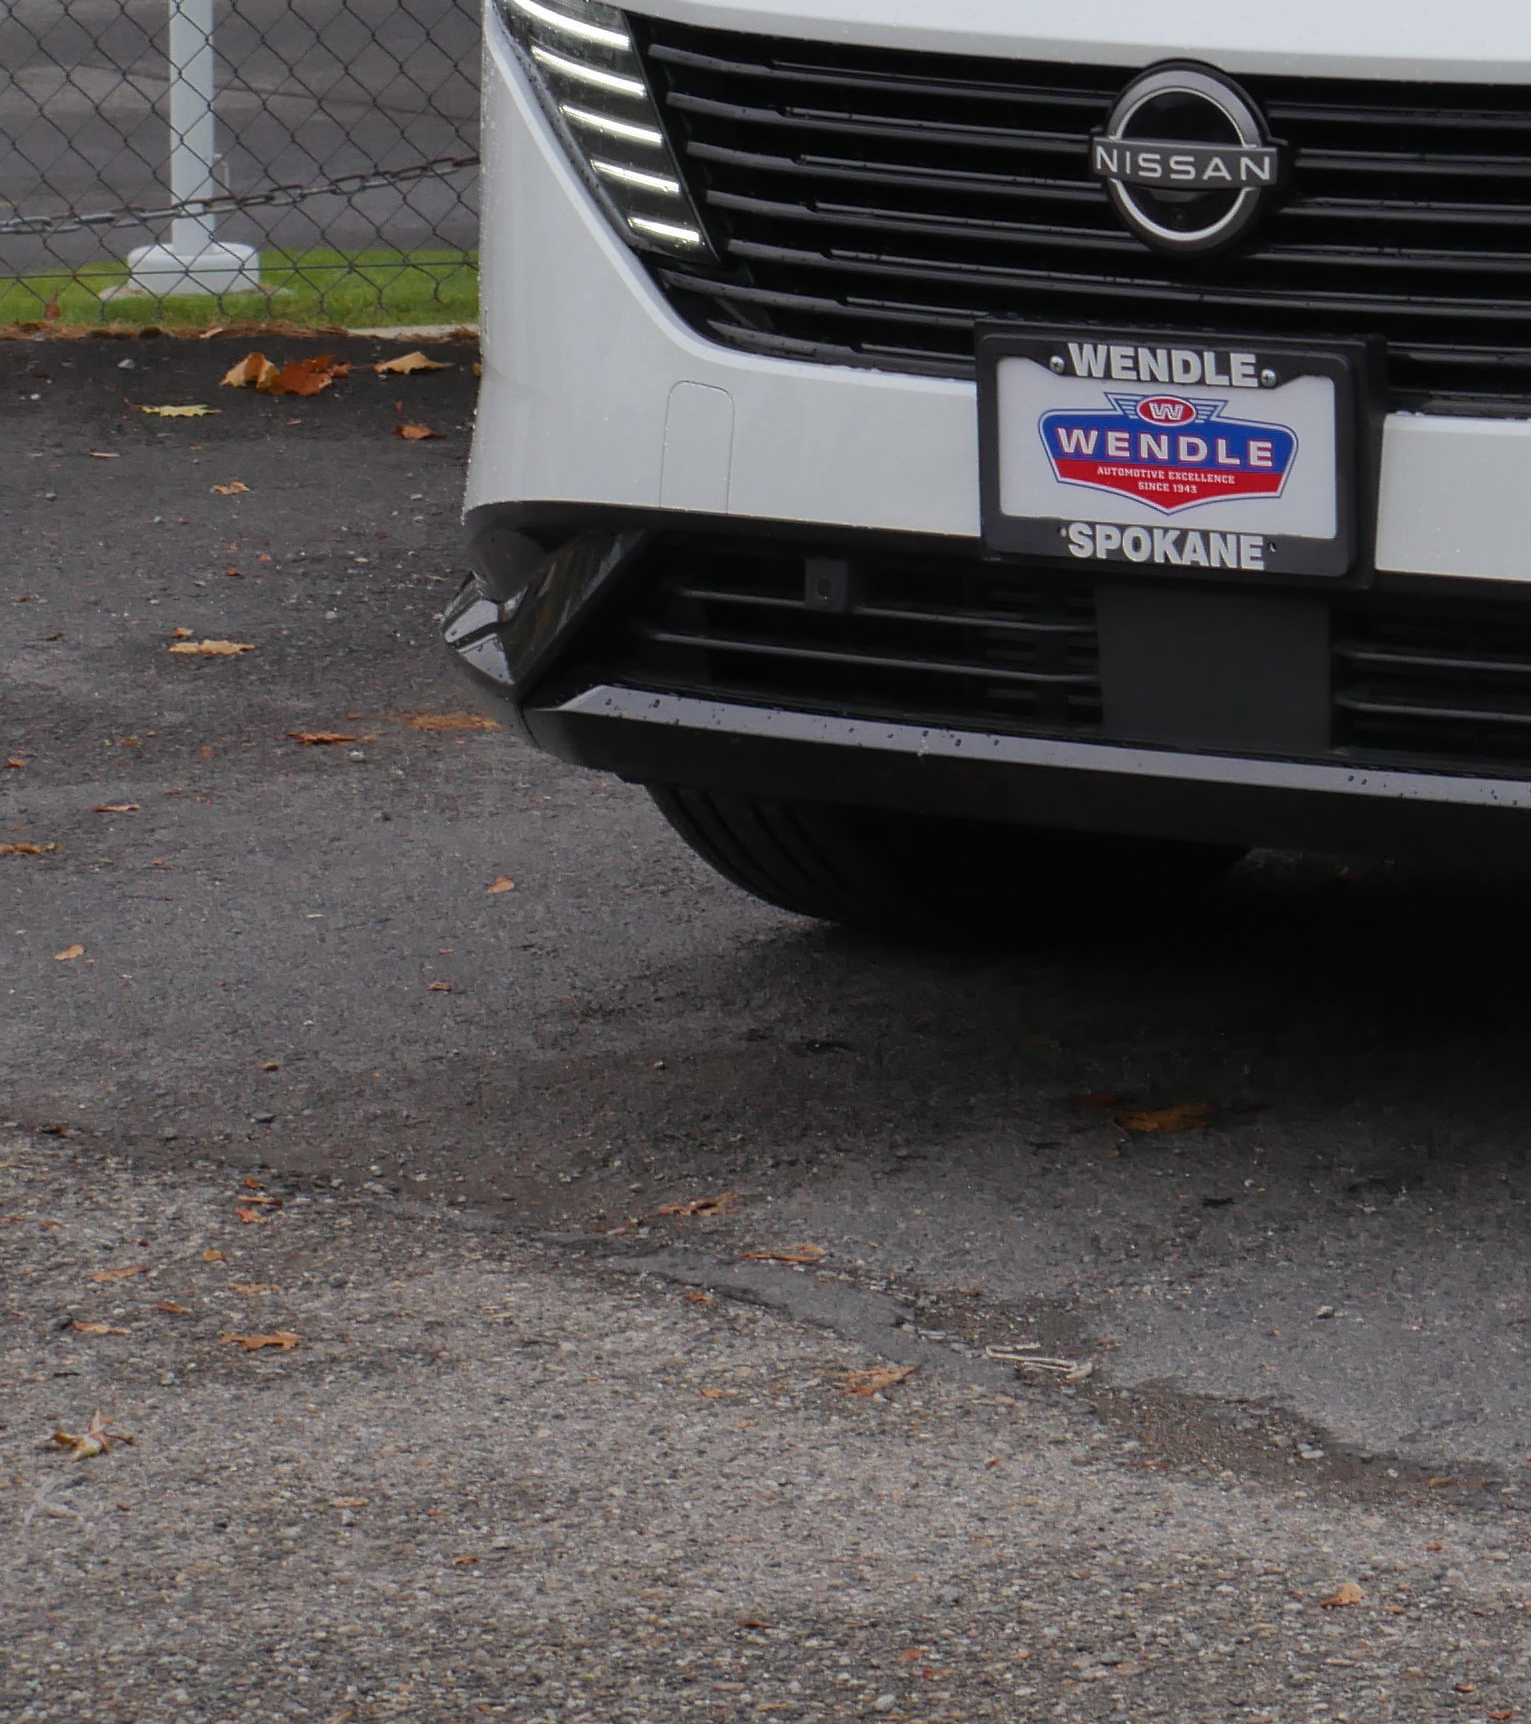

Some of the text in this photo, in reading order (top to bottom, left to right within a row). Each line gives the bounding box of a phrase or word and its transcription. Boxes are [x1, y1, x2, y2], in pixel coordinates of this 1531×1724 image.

[1095, 144, 1270, 181] NISSAN
[1067, 342, 1259, 388] WENDLE
[1057, 427, 1273, 468] WENDLE
[1096, 466, 1235, 485] AUTOMOTIVE EXCELLENCE
[1138, 481, 1198, 494] SINCE 1943
[1067, 522, 1266, 571] SPOKANE
